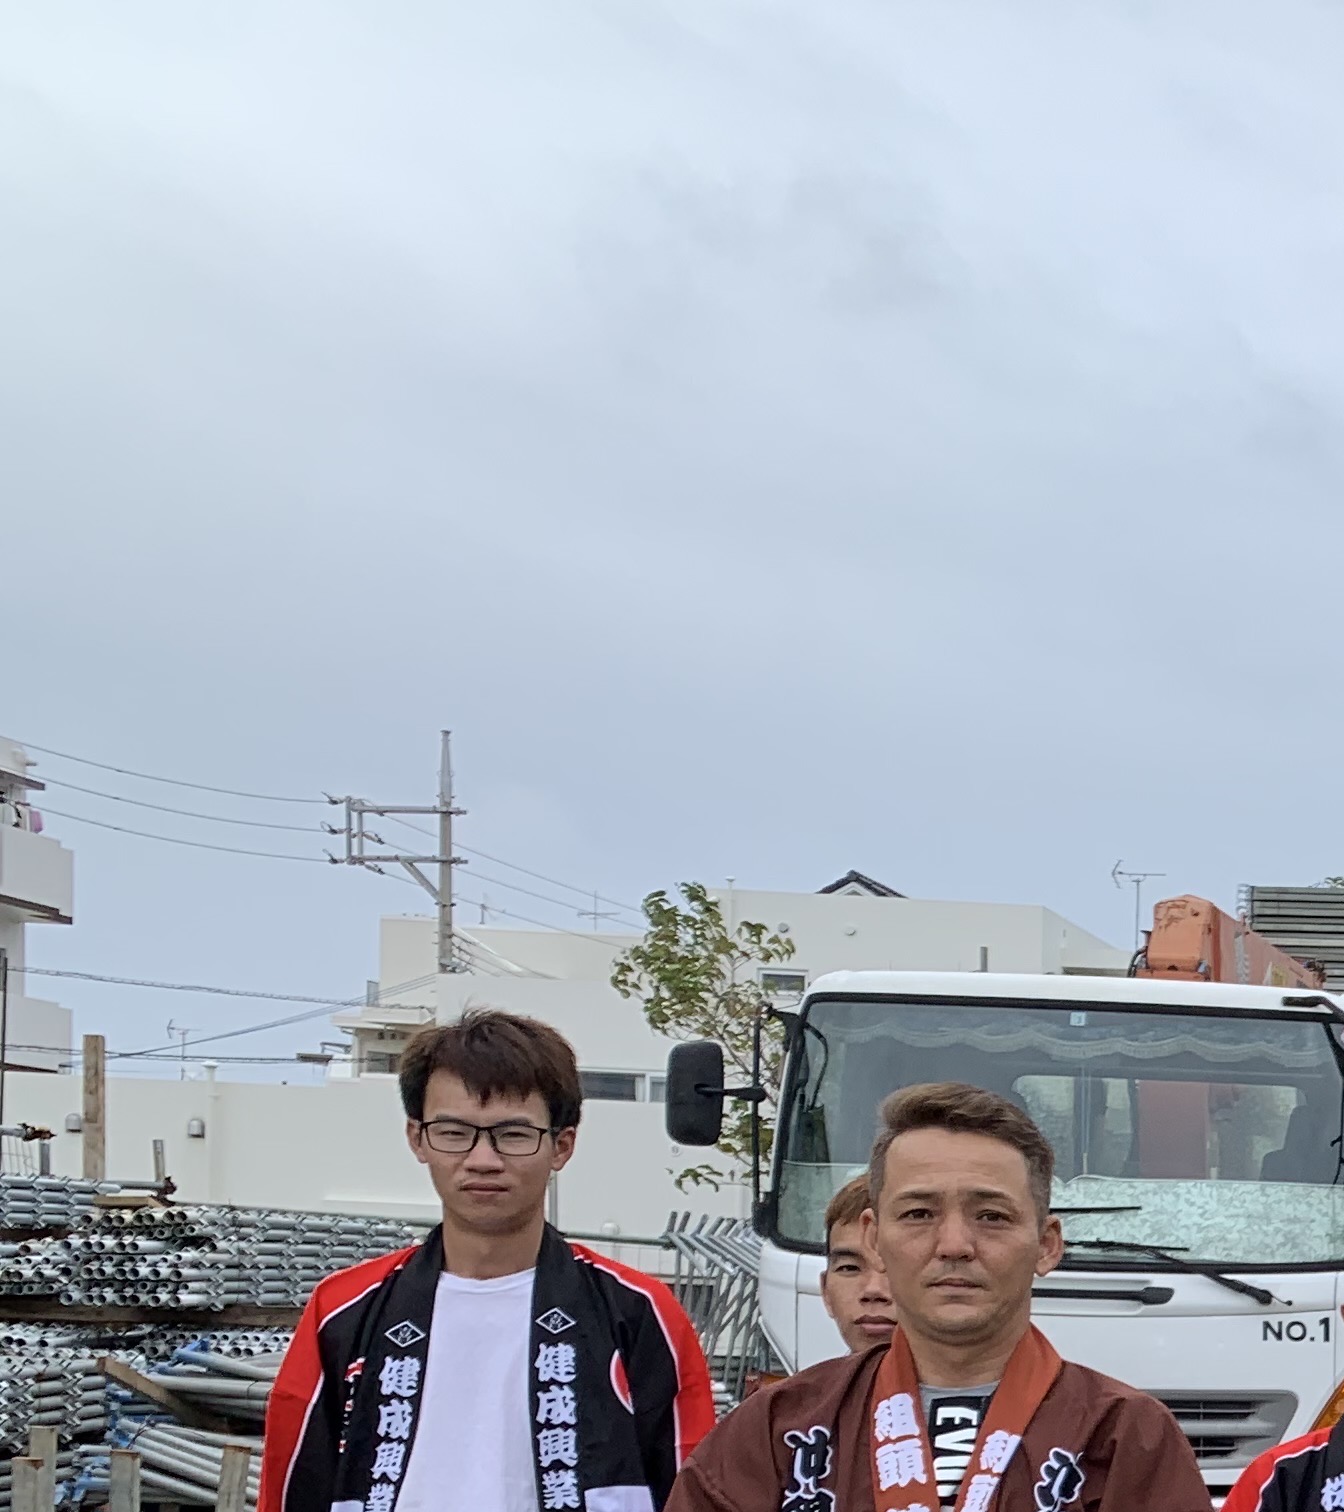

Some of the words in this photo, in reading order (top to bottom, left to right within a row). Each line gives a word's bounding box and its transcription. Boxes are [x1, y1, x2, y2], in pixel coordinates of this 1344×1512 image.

[1262, 1317, 1331, 1343] NO.1
[534, 1341, 581, 1510] 健成興業
